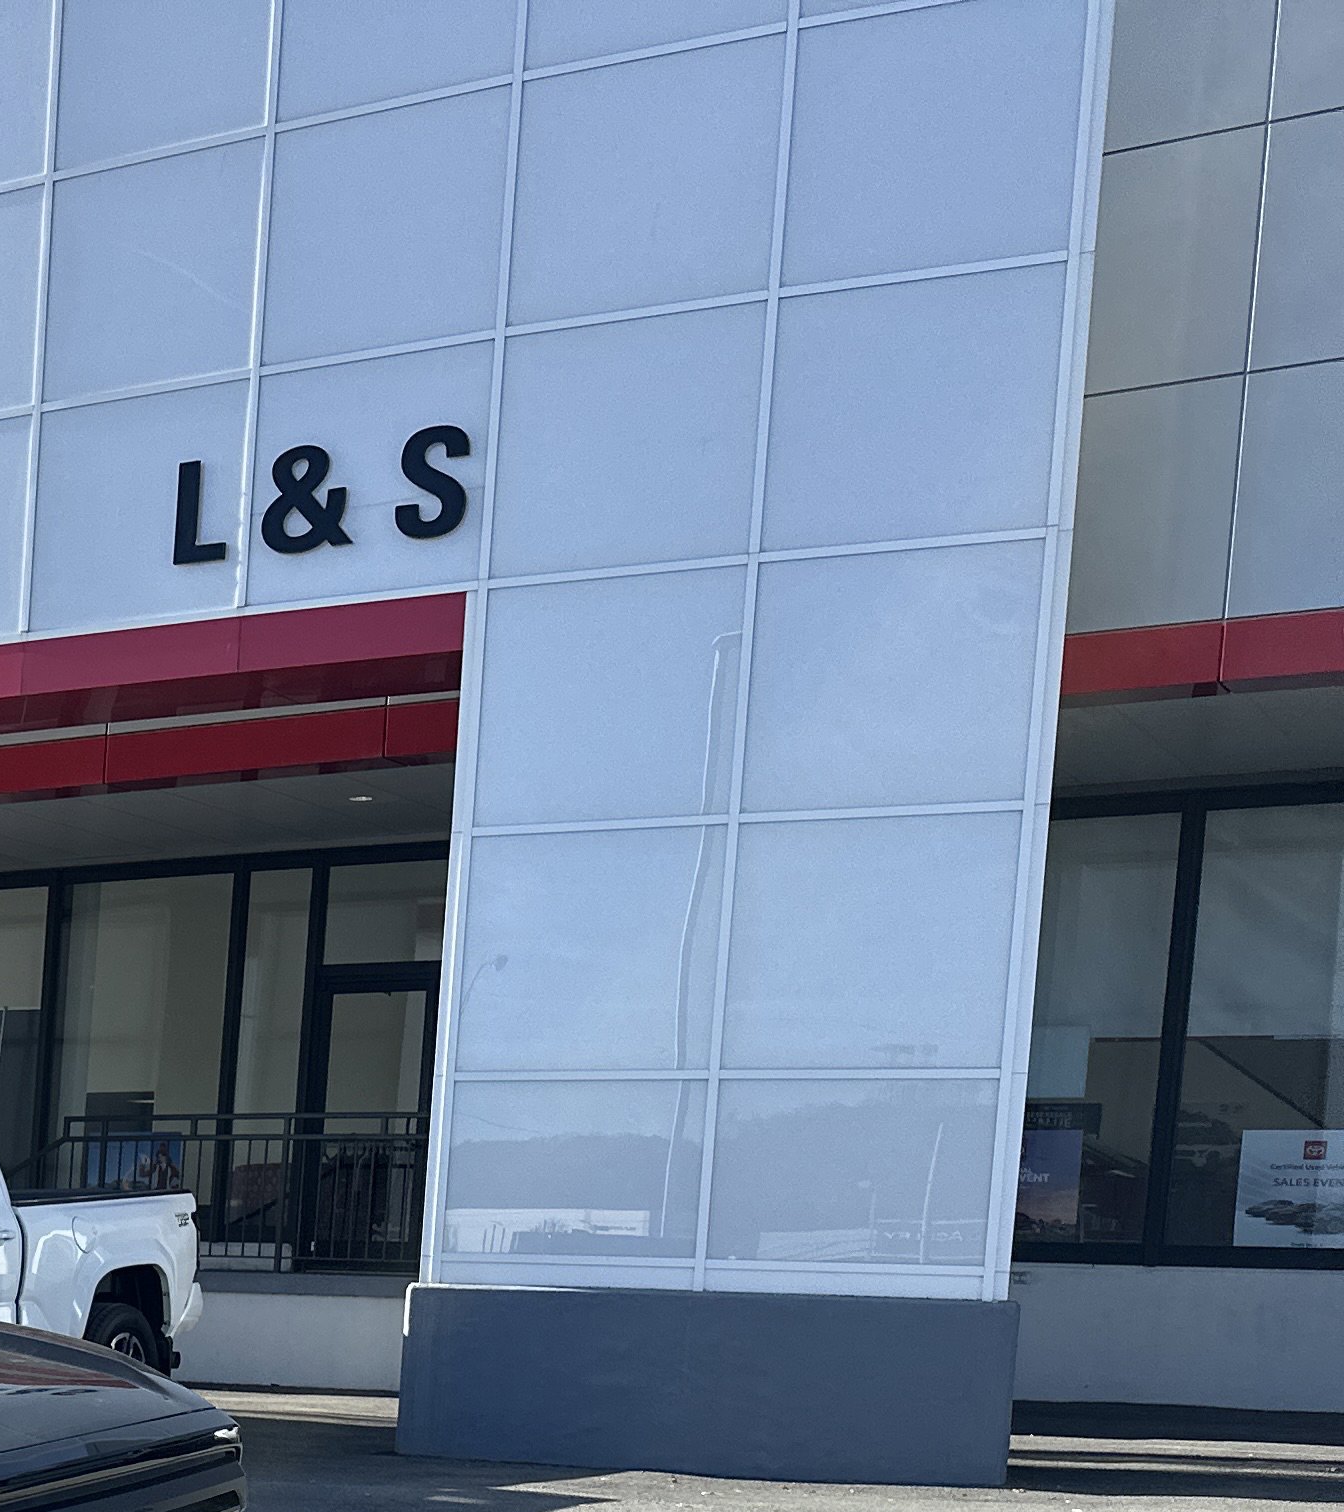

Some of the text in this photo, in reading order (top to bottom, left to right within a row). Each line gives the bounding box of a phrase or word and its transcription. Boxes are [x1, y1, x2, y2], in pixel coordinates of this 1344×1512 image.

[172, 424, 472, 566] L & S
[1020, 1172, 1051, 1183] VENT
[1272, 1177, 1344, 1187] SALES EVEN
